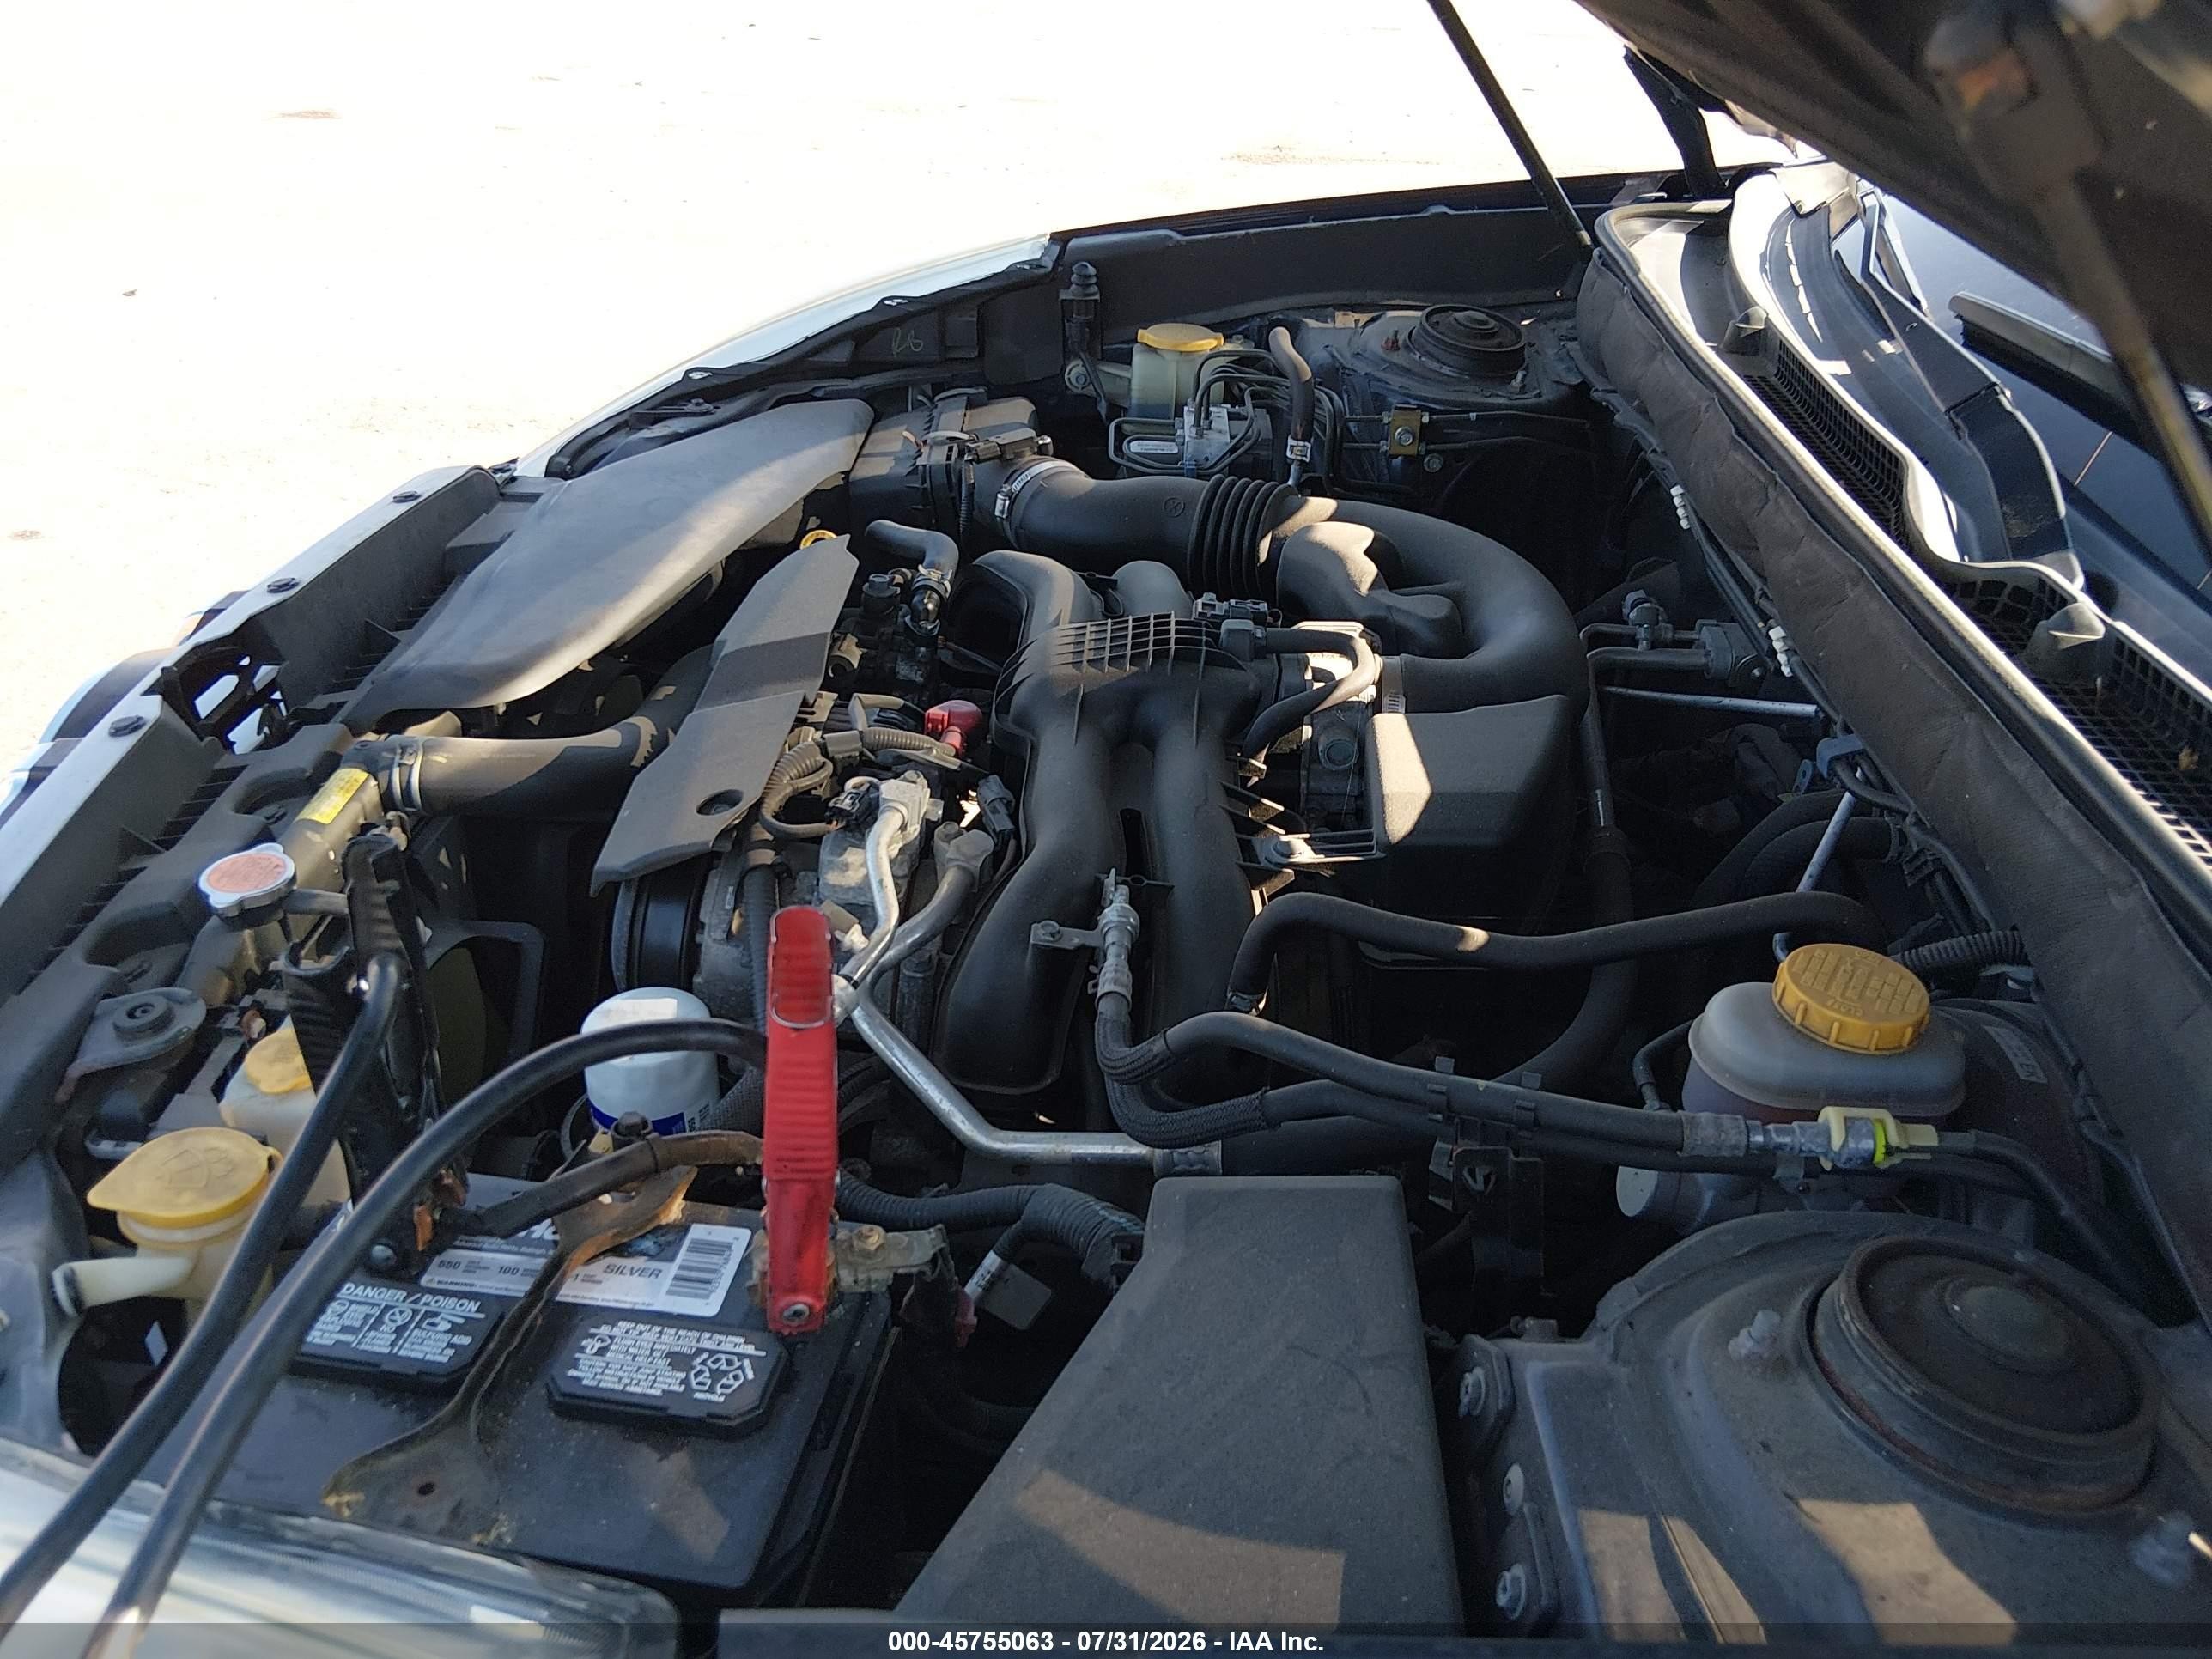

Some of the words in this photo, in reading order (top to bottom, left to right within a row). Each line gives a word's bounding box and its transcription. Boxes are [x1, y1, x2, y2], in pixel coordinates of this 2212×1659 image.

[603, 1264, 663, 1278] SILVER
[342, 1282, 407, 1303] DANGER
[419, 1294, 481, 1313] POISON
